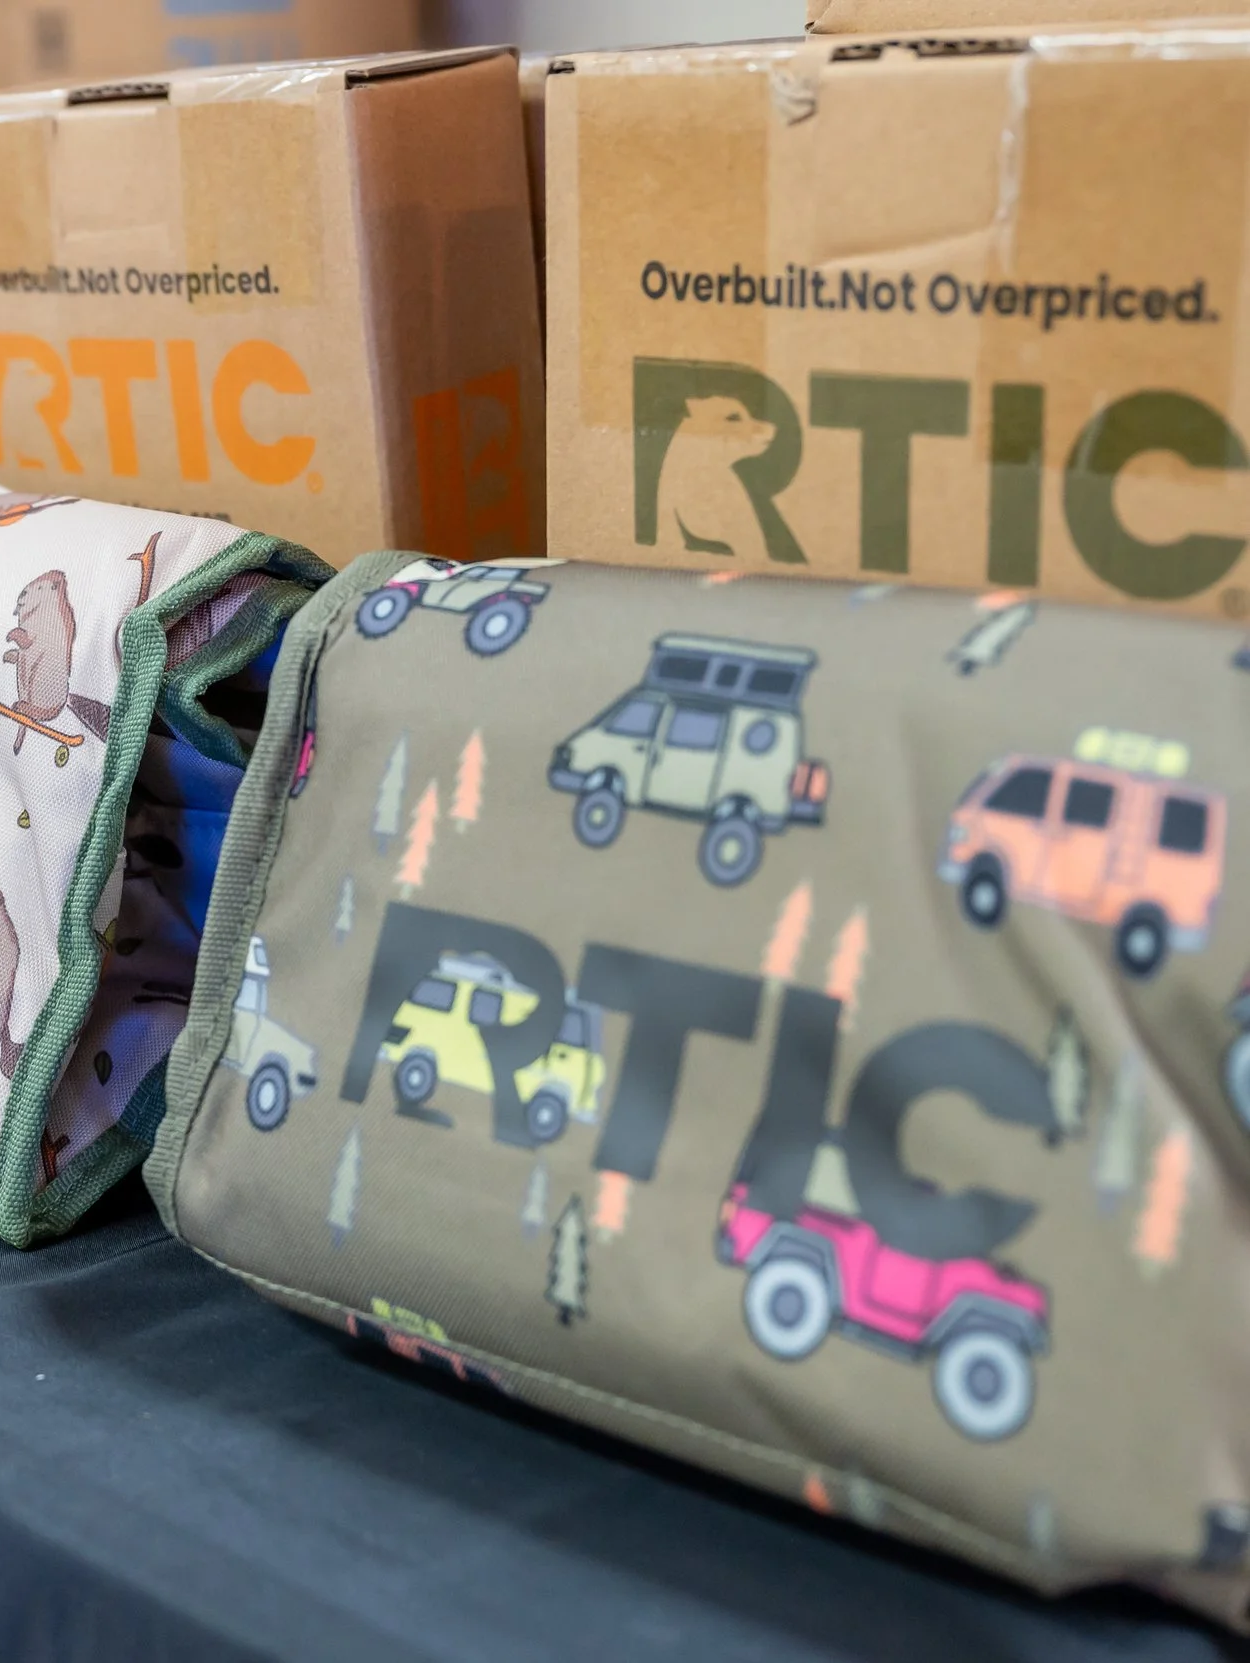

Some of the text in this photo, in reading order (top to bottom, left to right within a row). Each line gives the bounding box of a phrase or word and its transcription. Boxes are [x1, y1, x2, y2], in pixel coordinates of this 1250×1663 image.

[125, 264, 280, 302] Overpriced.
[928, 273, 1221, 332] Overpriced.
[633, 356, 1250, 600] RTIC
[339, 901, 1054, 1260] RTIC
